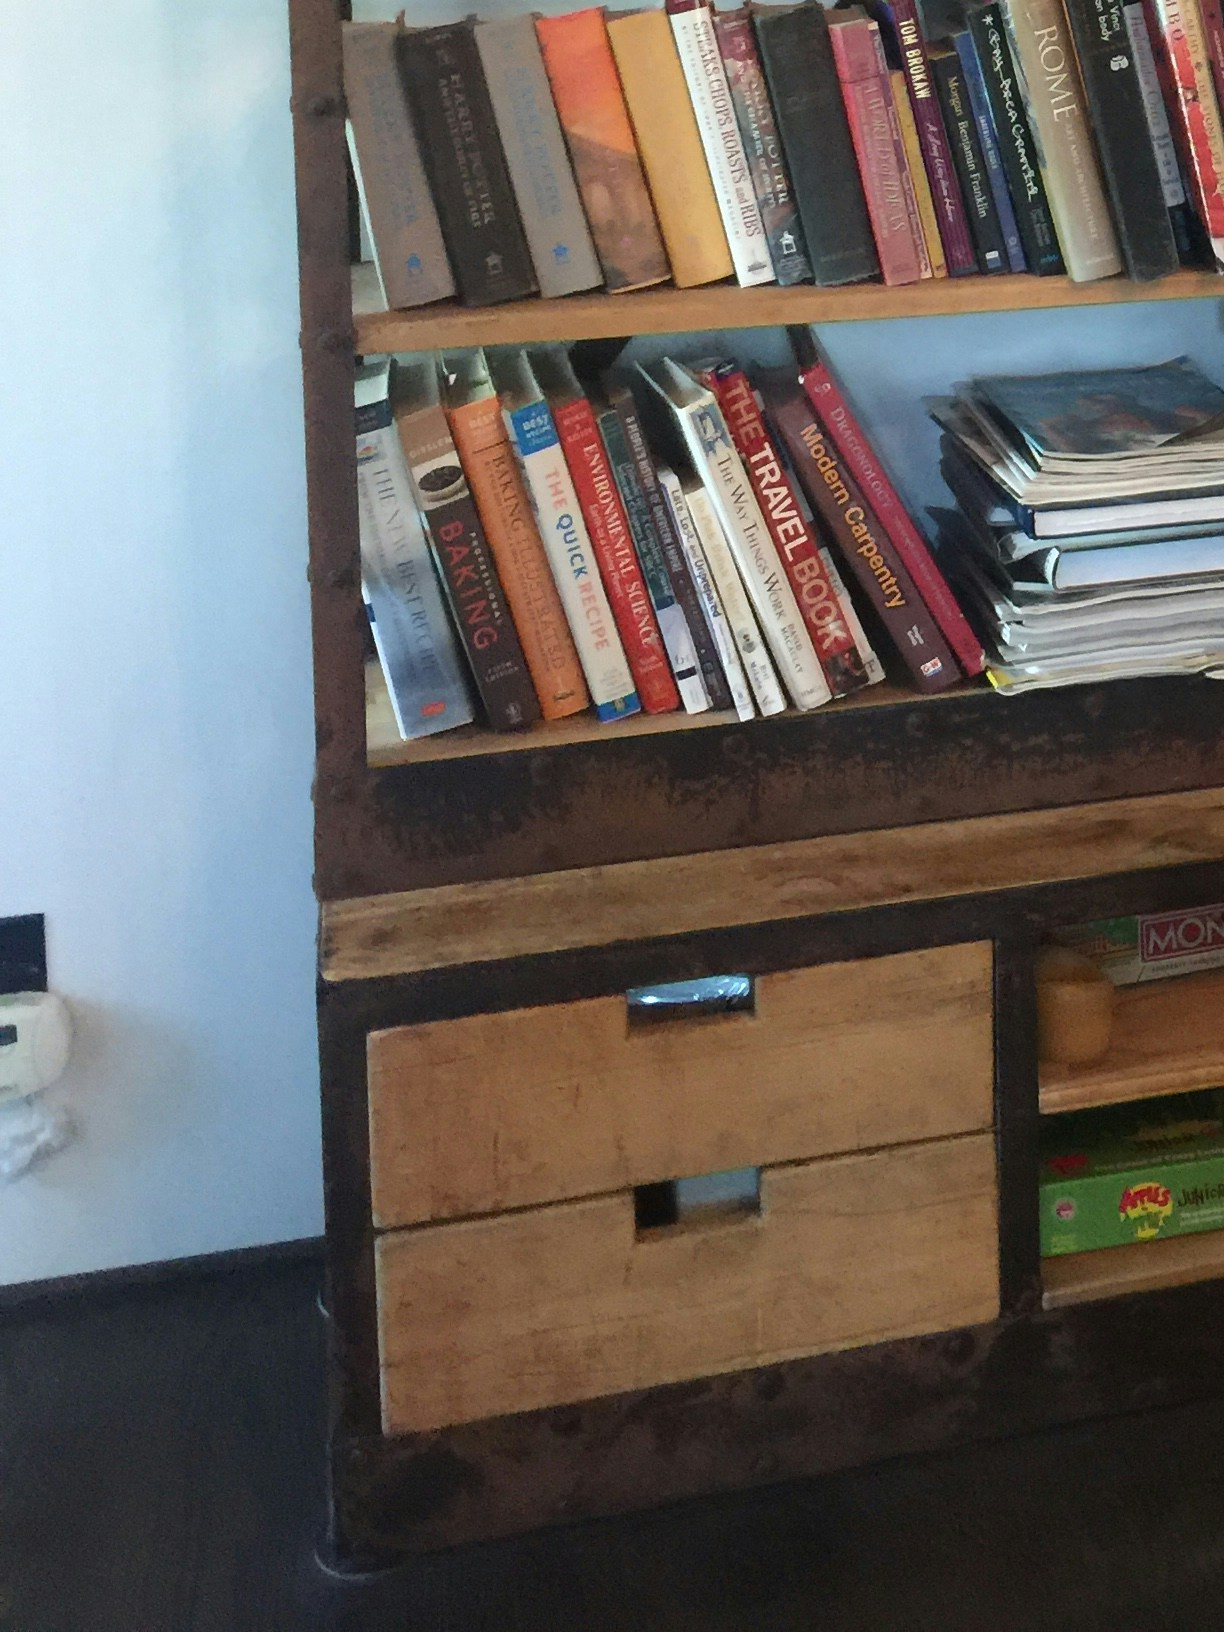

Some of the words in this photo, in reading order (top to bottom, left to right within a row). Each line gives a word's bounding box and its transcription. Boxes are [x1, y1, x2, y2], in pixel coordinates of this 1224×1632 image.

[897, 16, 919, 45] TOM
[1093, 14, 1114, 42] body
[1106, 4, 1125, 31] Vinci
[904, 47, 932, 100] BROKAW
[944, 75, 967, 116] Morgan
[1030, 23, 1079, 122] ROME
[865, 97, 893, 158] WORLD
[879, 177, 909, 233] IDEAS
[954, 119, 981, 171] Benjamin
[717, 129, 748, 185] ROASTS
[738, 203, 762, 239] RIBS
[967, 171, 992, 218] Franklin
[522, 414, 549, 431] BEST
[542, 466, 569, 510] THE
[720, 377, 766, 448] THE
[745, 441, 813, 562] TRAVEL
[789, 555, 849, 652] BOOK
[798, 421, 853, 507] Modern
[838, 503, 908, 613] Carpentry
[371, 467, 396, 501] THE
[394, 559, 425, 605] BEST
[490, 453, 527, 532] BAKING
[514, 536, 567, 670] ILLUSTRATED
[552, 511, 589, 581] QUICK
[581, 440, 635, 577] ENVIRONMENTAL
[624, 579, 658, 648] SCIENCE
[437, 517, 499, 651] BAKING
[576, 580, 610, 651] RECIPE
[691, 558, 722, 619] Unprepared
[785, 622, 803, 651] DAVID
